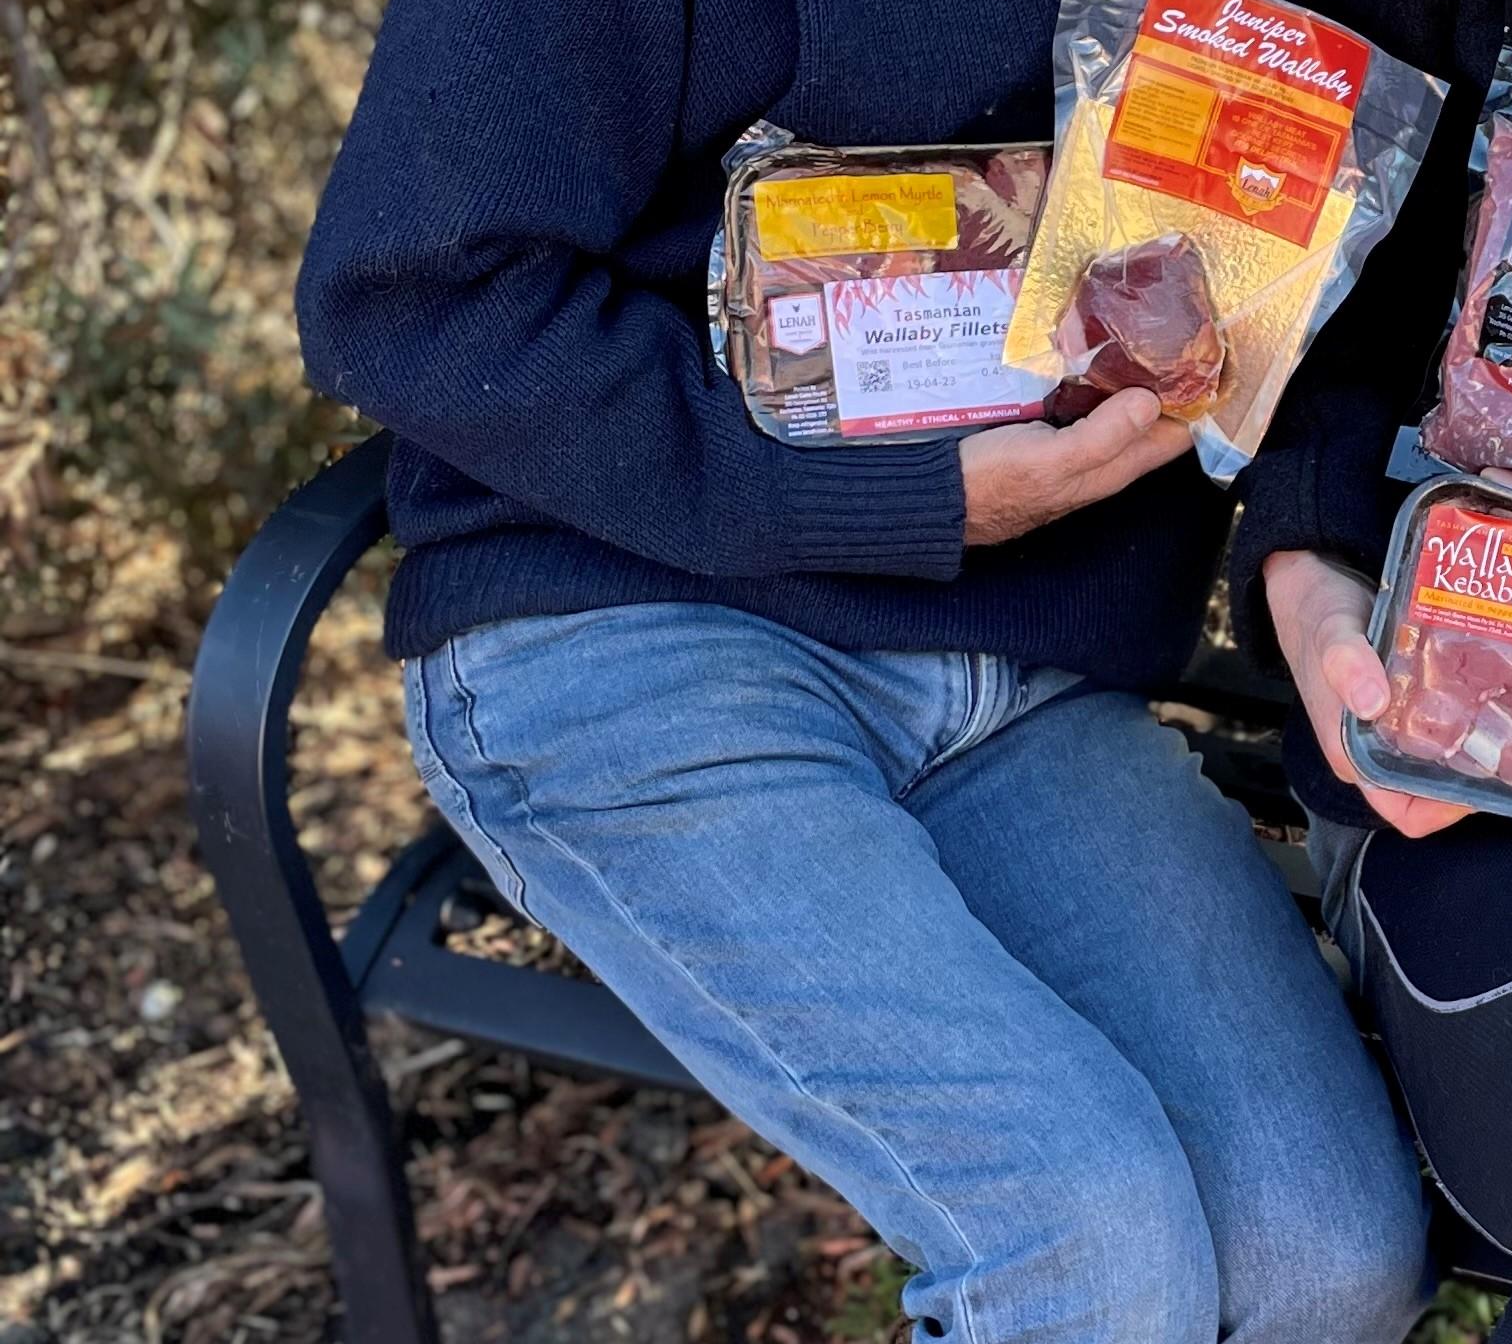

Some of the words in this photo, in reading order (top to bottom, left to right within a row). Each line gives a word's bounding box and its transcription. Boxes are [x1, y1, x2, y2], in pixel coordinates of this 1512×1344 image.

[1154, 9, 1255, 57] Smoked
[1257, 40, 1352, 101] Wallaby
[766, 194, 832, 209] Marinated
[851, 189, 897, 203] Lemon
[899, 185, 943, 204] Myrtle
[779, 315, 816, 328] LENAH
[894, 304, 982, 322] Tasmanian
[865, 327, 943, 345] Wallaby
[950, 322, 1009, 338] Fillets
[926, 357, 956, 369] Before
[875, 417, 914, 429] HEALTHY
[922, 412, 959, 425] ETHICAL
[967, 408, 1021, 421] TASMANIAN
